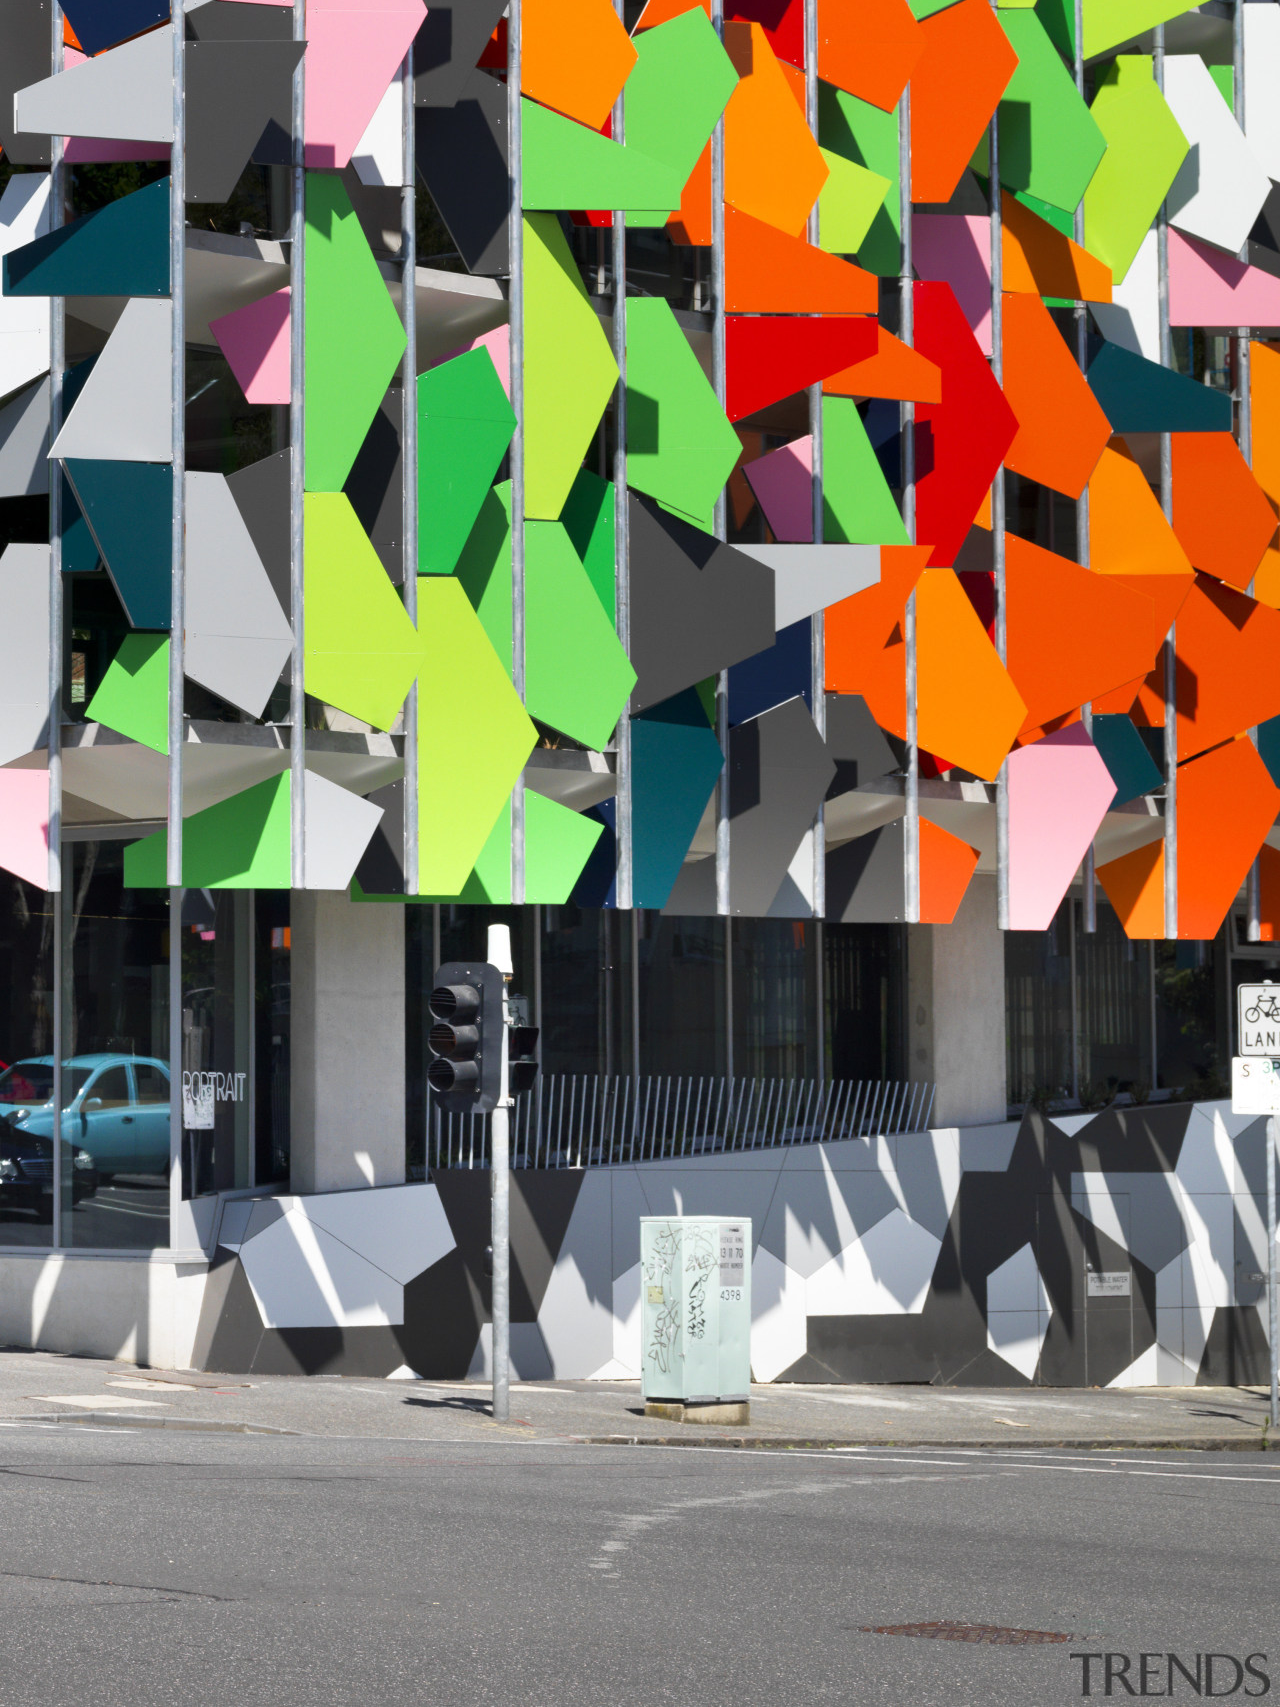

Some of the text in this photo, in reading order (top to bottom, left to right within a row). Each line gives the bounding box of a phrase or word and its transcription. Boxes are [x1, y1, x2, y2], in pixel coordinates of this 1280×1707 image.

[1245, 1031, 1280, 1047] LAN
[182, 1070, 247, 1102] PORTRAIT
[720, 1247, 727, 1258] 13
[735, 1248, 744, 1259] 70
[720, 1289, 742, 1300] 4398
